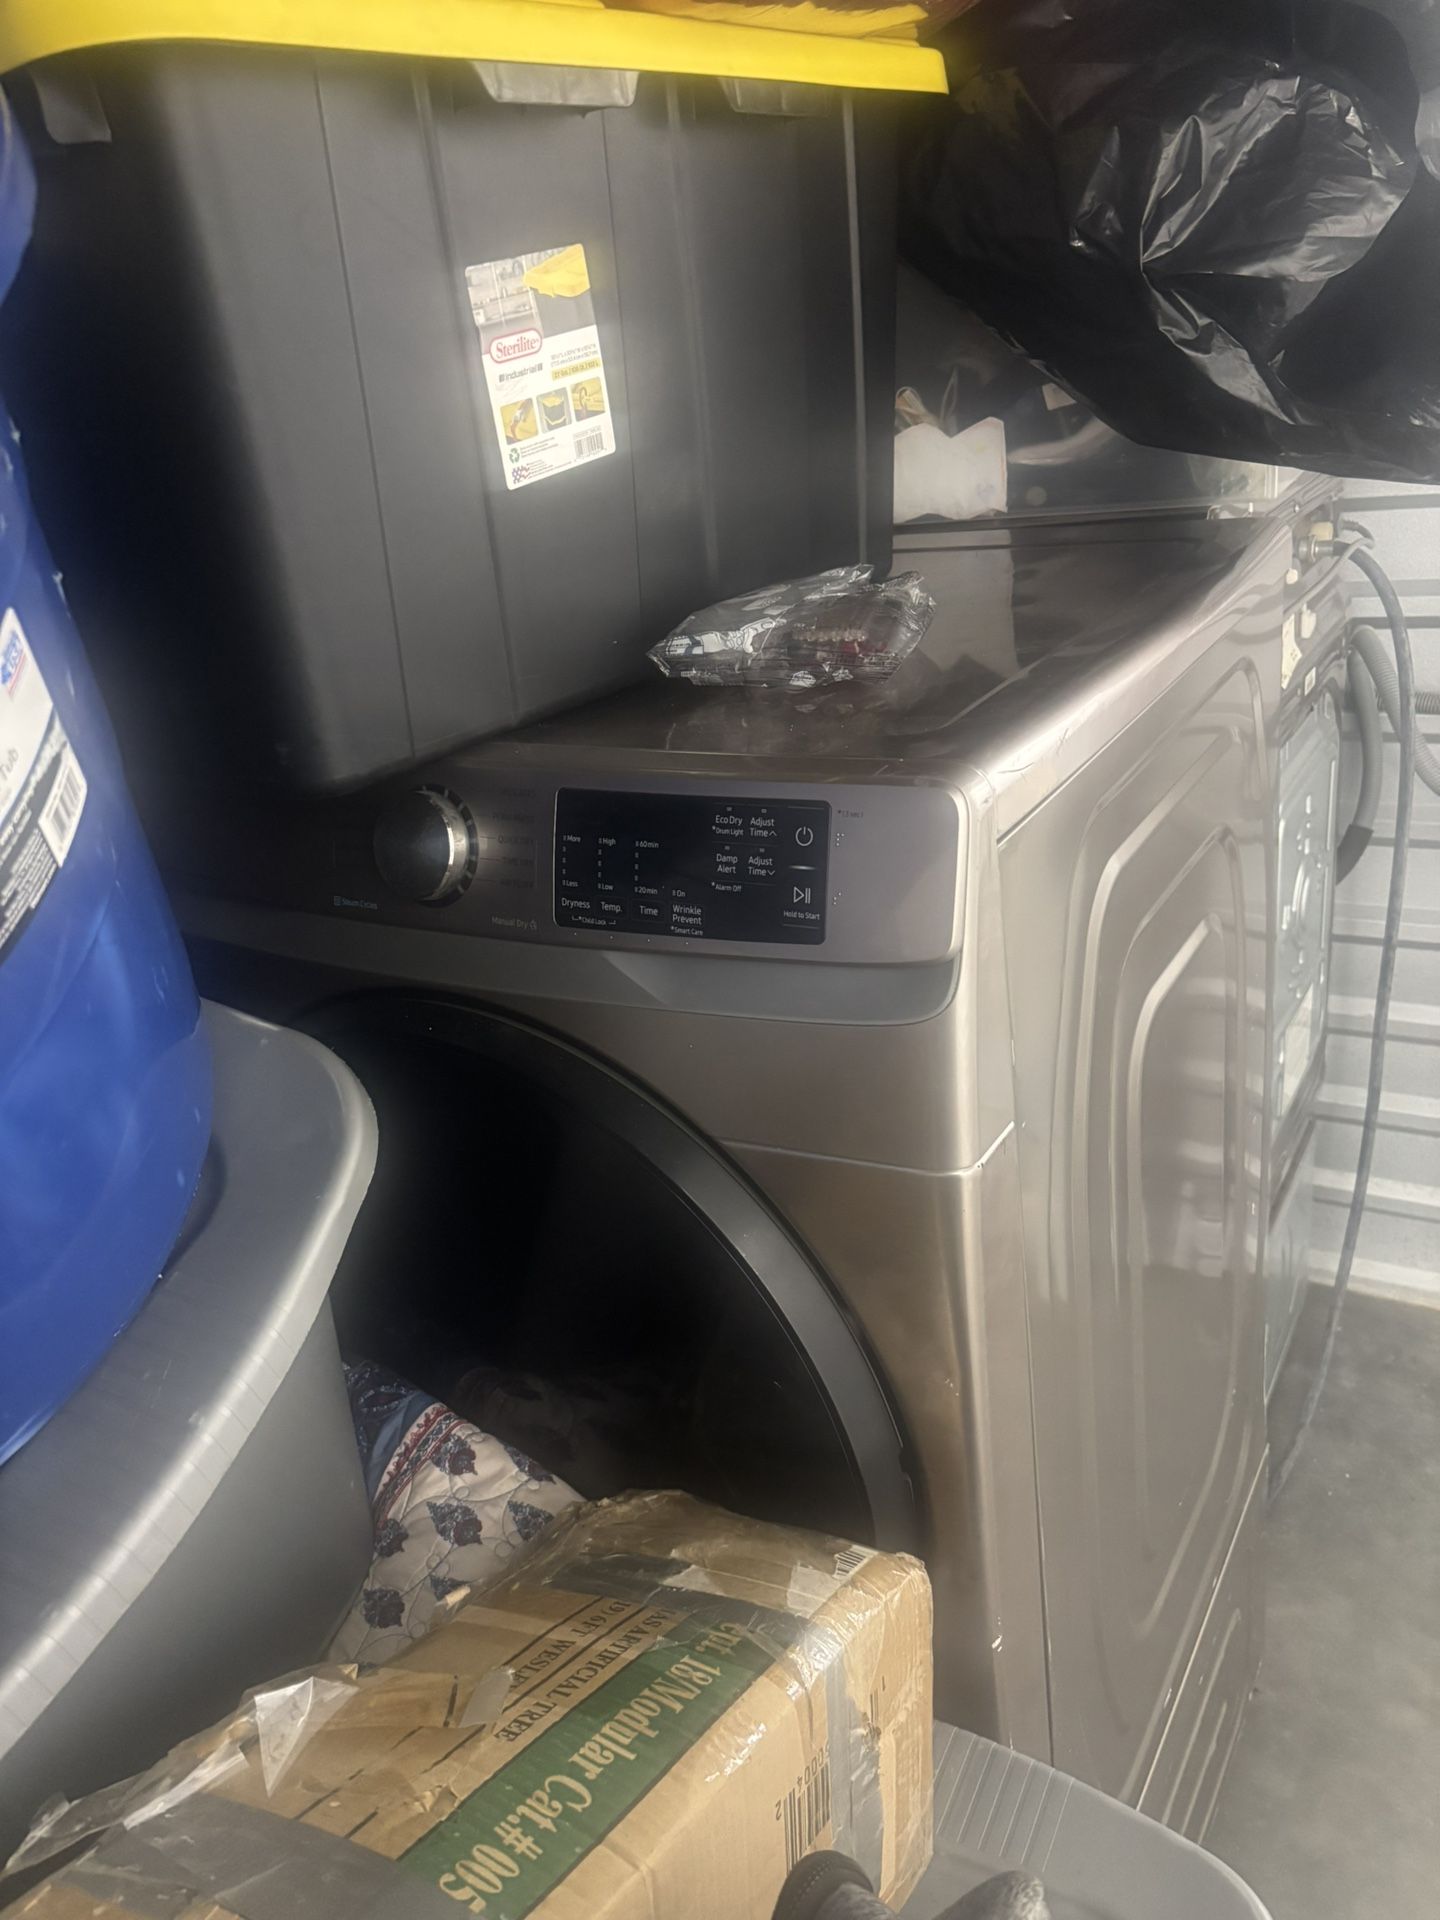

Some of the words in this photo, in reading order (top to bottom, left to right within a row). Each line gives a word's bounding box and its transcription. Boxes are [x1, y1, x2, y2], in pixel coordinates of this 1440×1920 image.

[495, 336, 537, 359] Sterilite
[716, 815, 729, 824] Eco
[729, 816, 743, 826] Dry
[750, 817, 775, 828] Adjust
[730, 828, 744, 837] Light
[750, 827, 769, 837] Time
[567, 835, 581, 843] More
[602, 838, 617, 847] High
[716, 853, 739, 864] Damp
[748, 856, 773, 867] Adjust
[717, 864, 737, 874] Alert
[748, 866, 767, 876] Time
[602, 883, 614, 891] Low
[676, 889, 686, 897] On
[561, 897, 591, 909] Dryness
[600, 901, 623, 913] Temp.
[640, 905, 659, 917] Time
[672, 904, 702, 915] Wrinkle
[672, 914, 702, 925] Prevent
[783, 910, 797, 918] Hold
[797, 911, 805, 919] to
[804, 911, 821, 921] Start
[691, 928, 703, 936] Care
[570, 1615, 608, 1638] 6FT
[694, 1622, 745, 1656] ept.
[510, 1639, 577, 1690] WESLE
[546, 1624, 649, 1699] ARTIFICIAL
[494, 1701, 558, 1742] TREE
[775, 1799, 783, 1821] 2
[439, 1843, 521, 1914] 005
